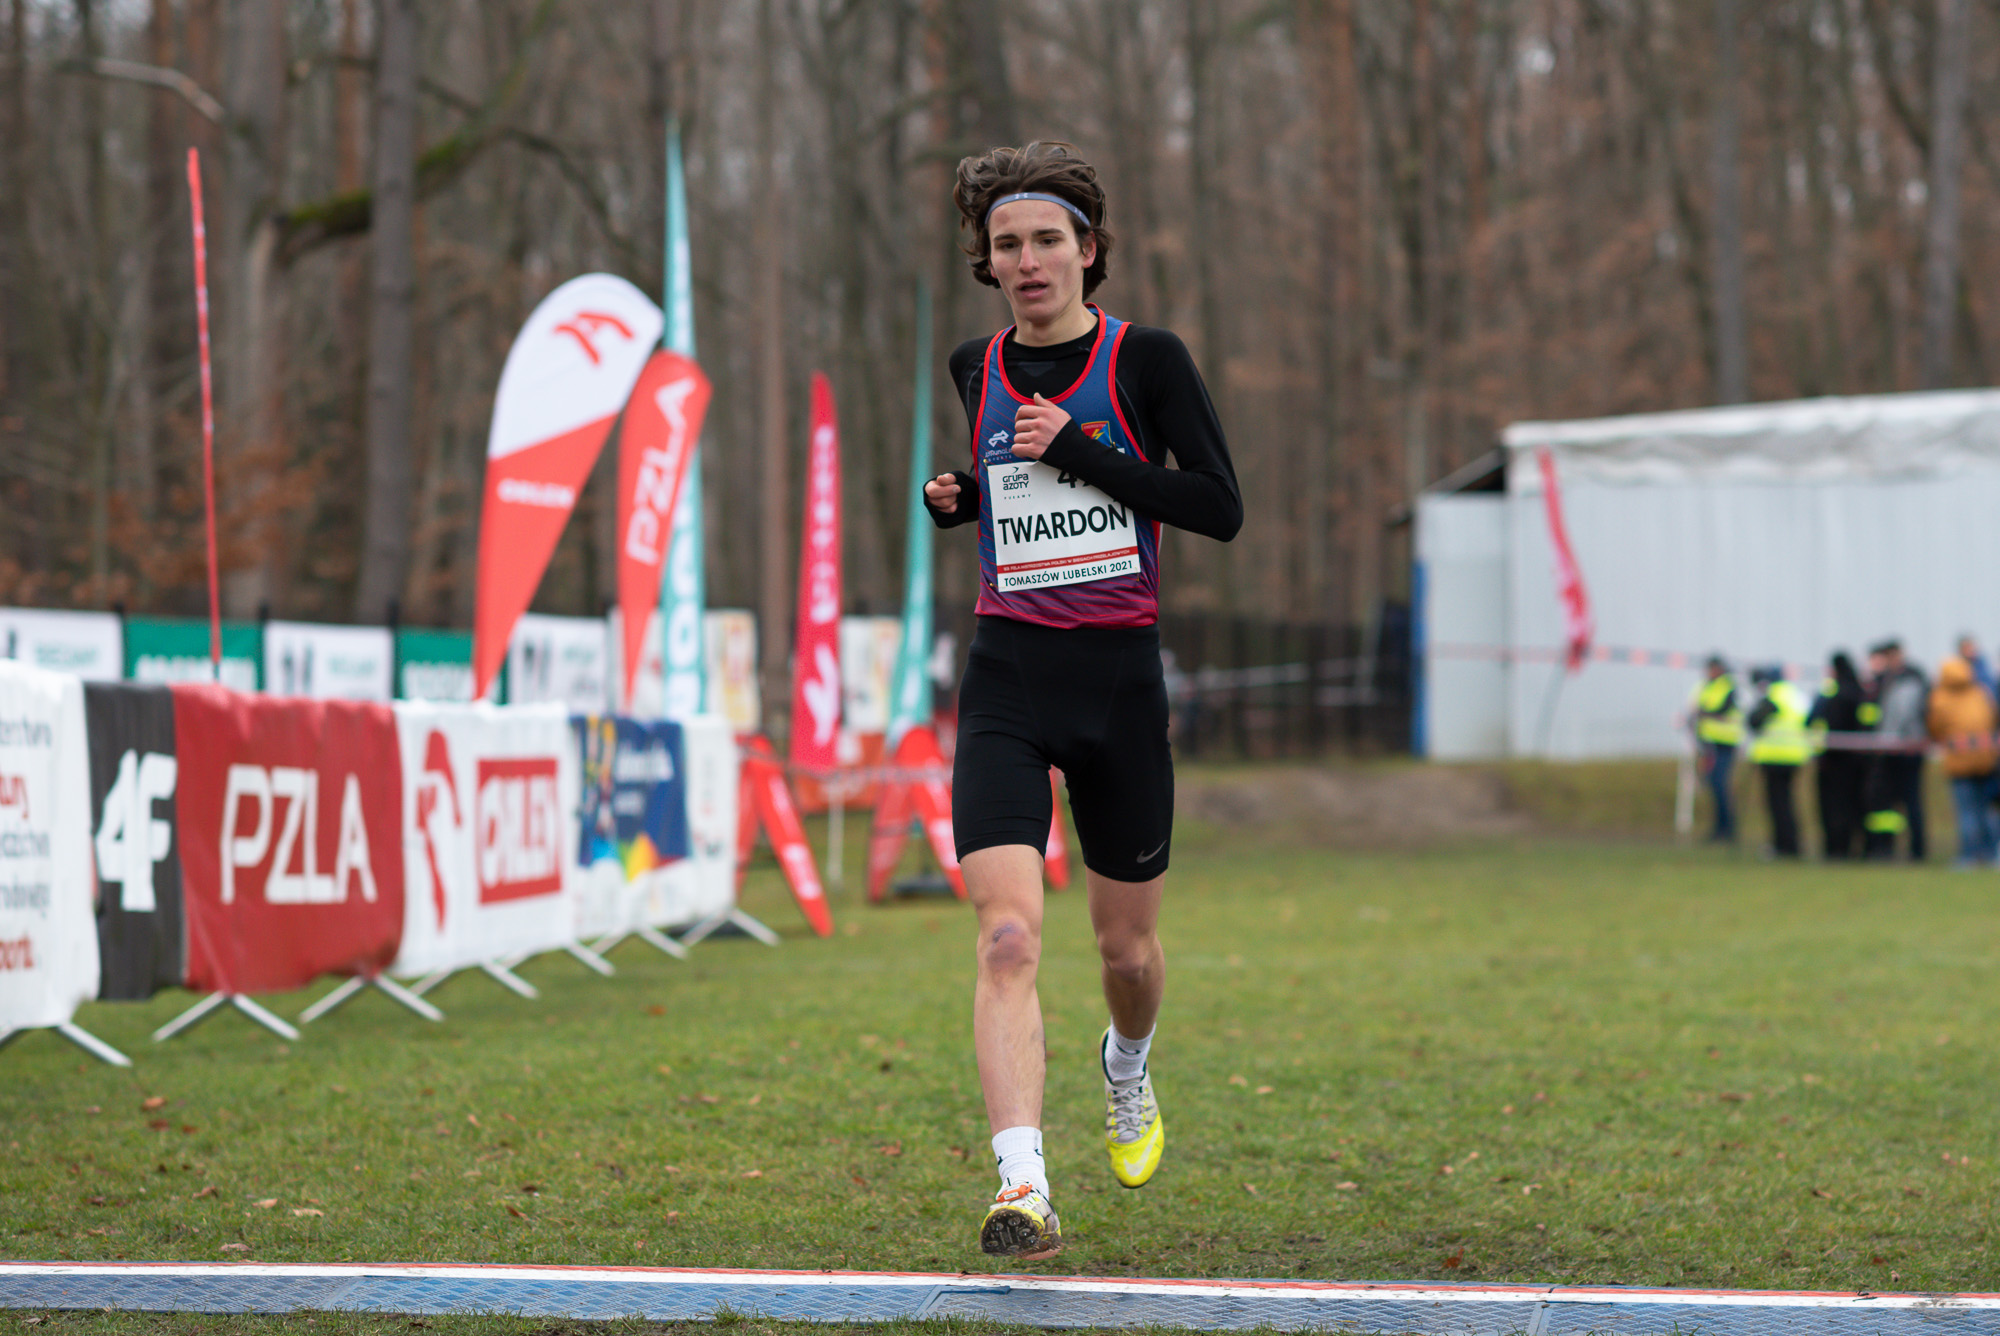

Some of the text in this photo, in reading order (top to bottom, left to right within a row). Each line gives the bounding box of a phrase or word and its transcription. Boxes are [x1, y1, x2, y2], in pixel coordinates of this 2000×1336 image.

[626, 376, 696, 567] PZLA
[1004, 560, 1133, 587] TOMASZÓW LUBELSKI 2021
[96, 748, 177, 912] 4F
[220, 763, 378, 905] PZLA
